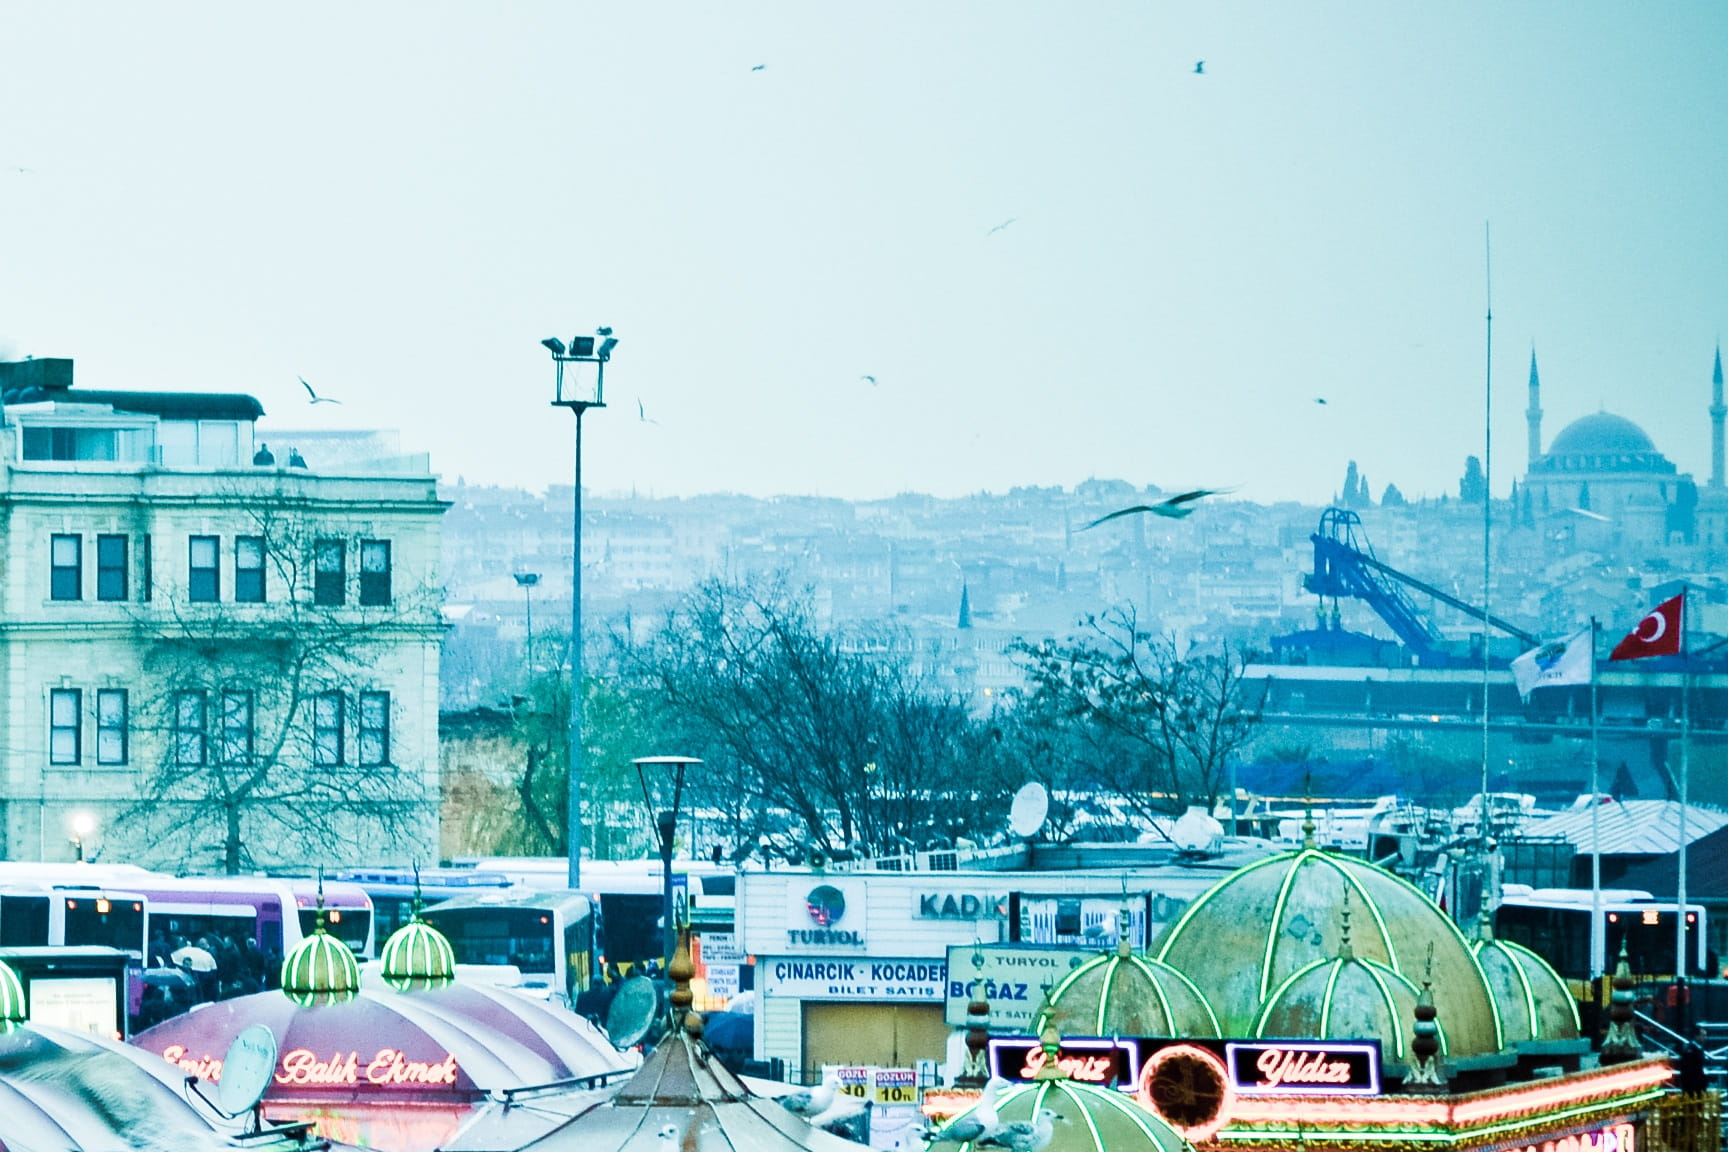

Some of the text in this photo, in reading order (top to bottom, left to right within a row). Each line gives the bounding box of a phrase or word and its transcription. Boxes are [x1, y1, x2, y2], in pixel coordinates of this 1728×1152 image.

[920, 894, 1008, 918] KADIK
[788, 929, 864, 945] TURYOL
[995, 956, 1059, 968] TURYOL
[775, 962, 946, 984] ÇINARCIK KOCADER
[1006, 1010, 1033, 1020] SATI
[275, 1048, 358, 1084] Balık
[366, 1047, 457, 1084] Ekmek
